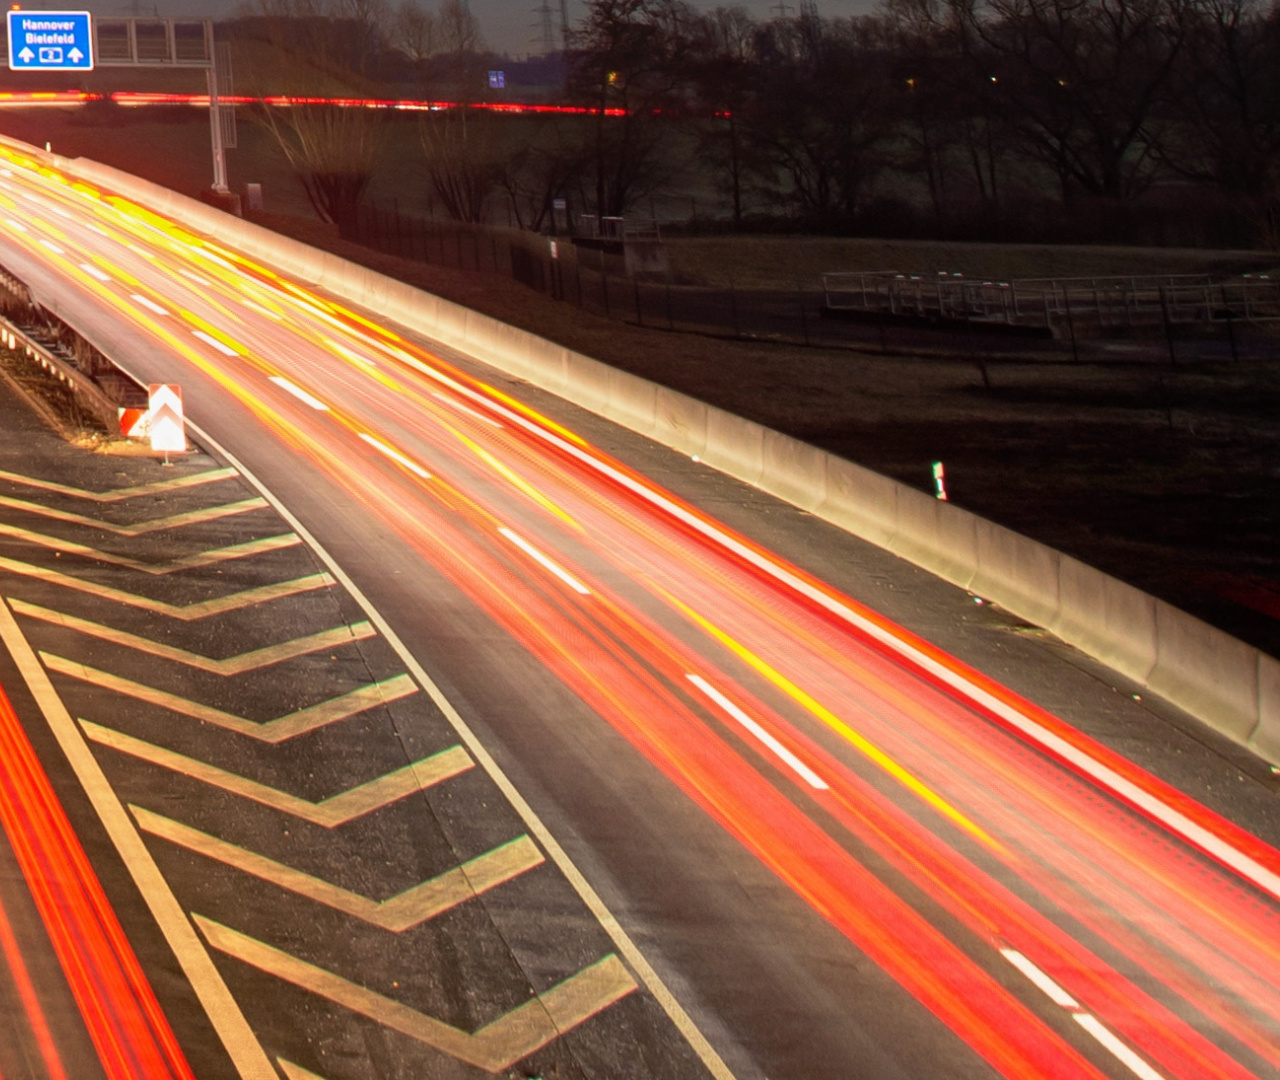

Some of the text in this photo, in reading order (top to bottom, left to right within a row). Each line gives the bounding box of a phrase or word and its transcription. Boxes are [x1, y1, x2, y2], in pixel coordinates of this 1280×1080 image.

[22, 19, 75, 30] Hannover
[25, 32, 75, 44] Bielefeld
[47, 50, 55, 60] 2
